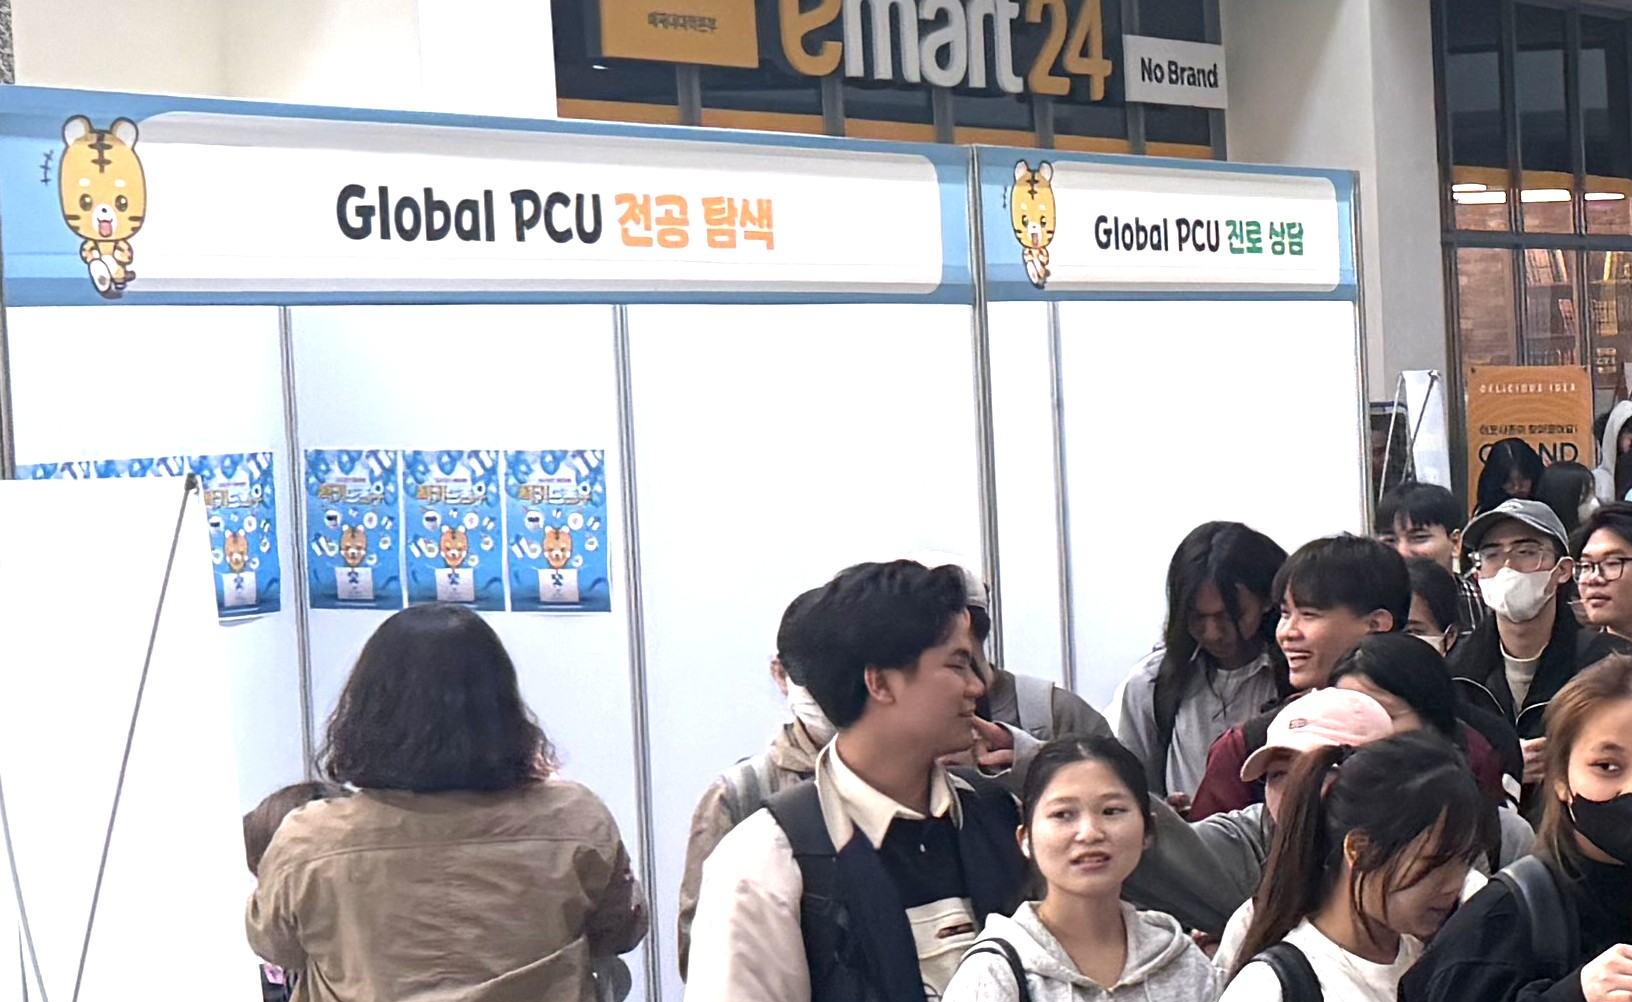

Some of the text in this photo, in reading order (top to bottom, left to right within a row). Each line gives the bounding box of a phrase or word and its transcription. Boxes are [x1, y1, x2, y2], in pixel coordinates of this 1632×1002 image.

[1140, 57, 1218, 88] No Brand
[337, 184, 774, 250] Global PCU 전공 탐색
[1095, 215, 1303, 255] Global PCU 진로 상담
